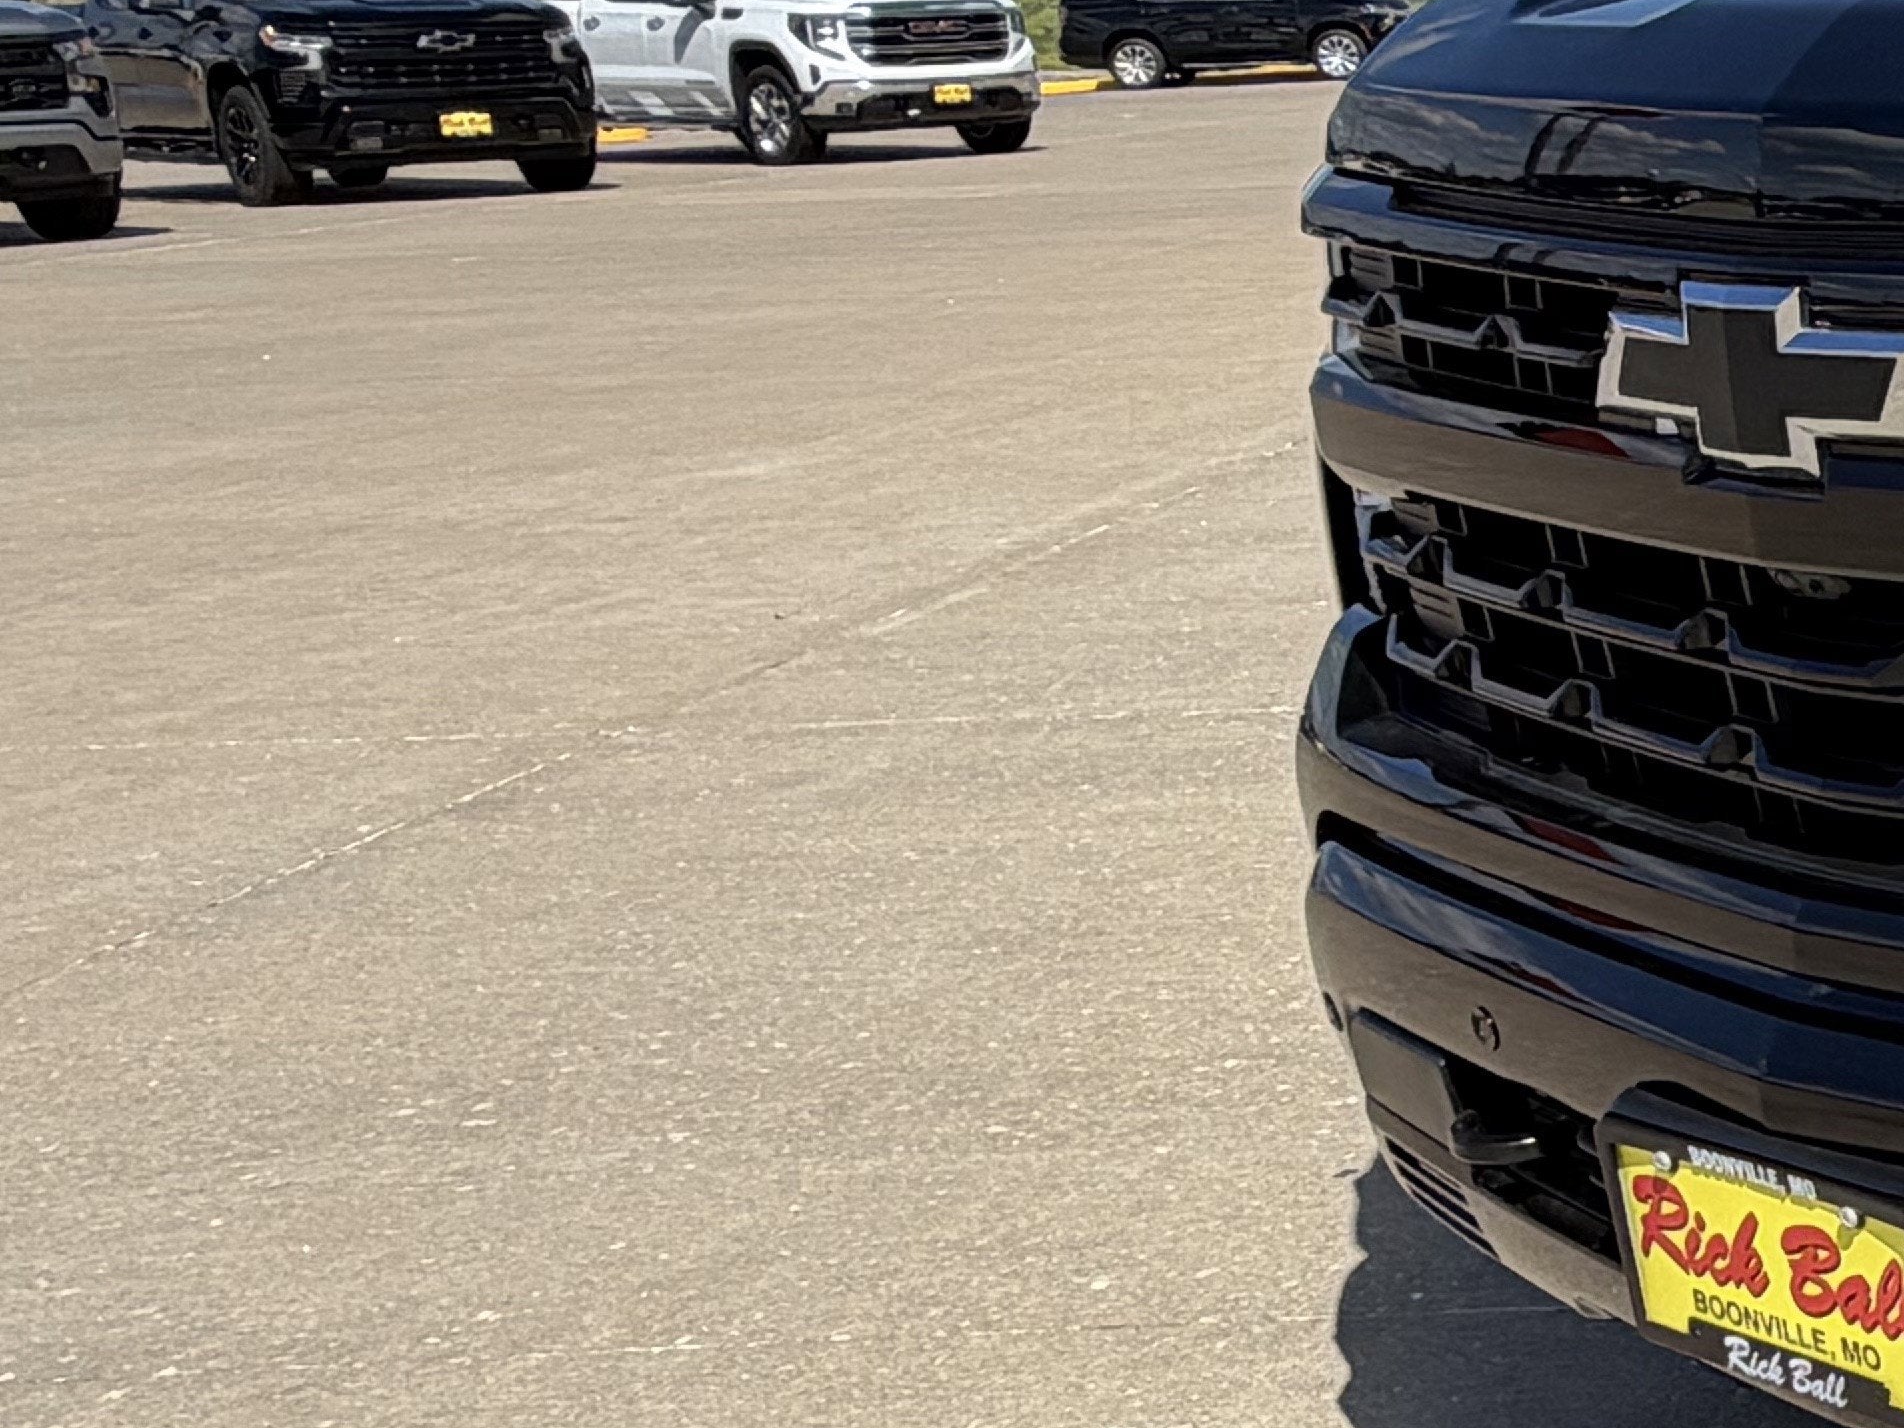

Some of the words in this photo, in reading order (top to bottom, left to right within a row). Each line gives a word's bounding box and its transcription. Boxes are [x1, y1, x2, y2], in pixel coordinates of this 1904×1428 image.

[1788, 1175, 1818, 1200] MO
[1632, 1174, 1771, 1299] Rick
[1692, 1289, 1837, 1362] BOONVILLE,
[1840, 1336, 1882, 1371] MO
[1723, 1335, 1788, 1388] Rick
[1787, 1357, 1849, 1409] Ball
